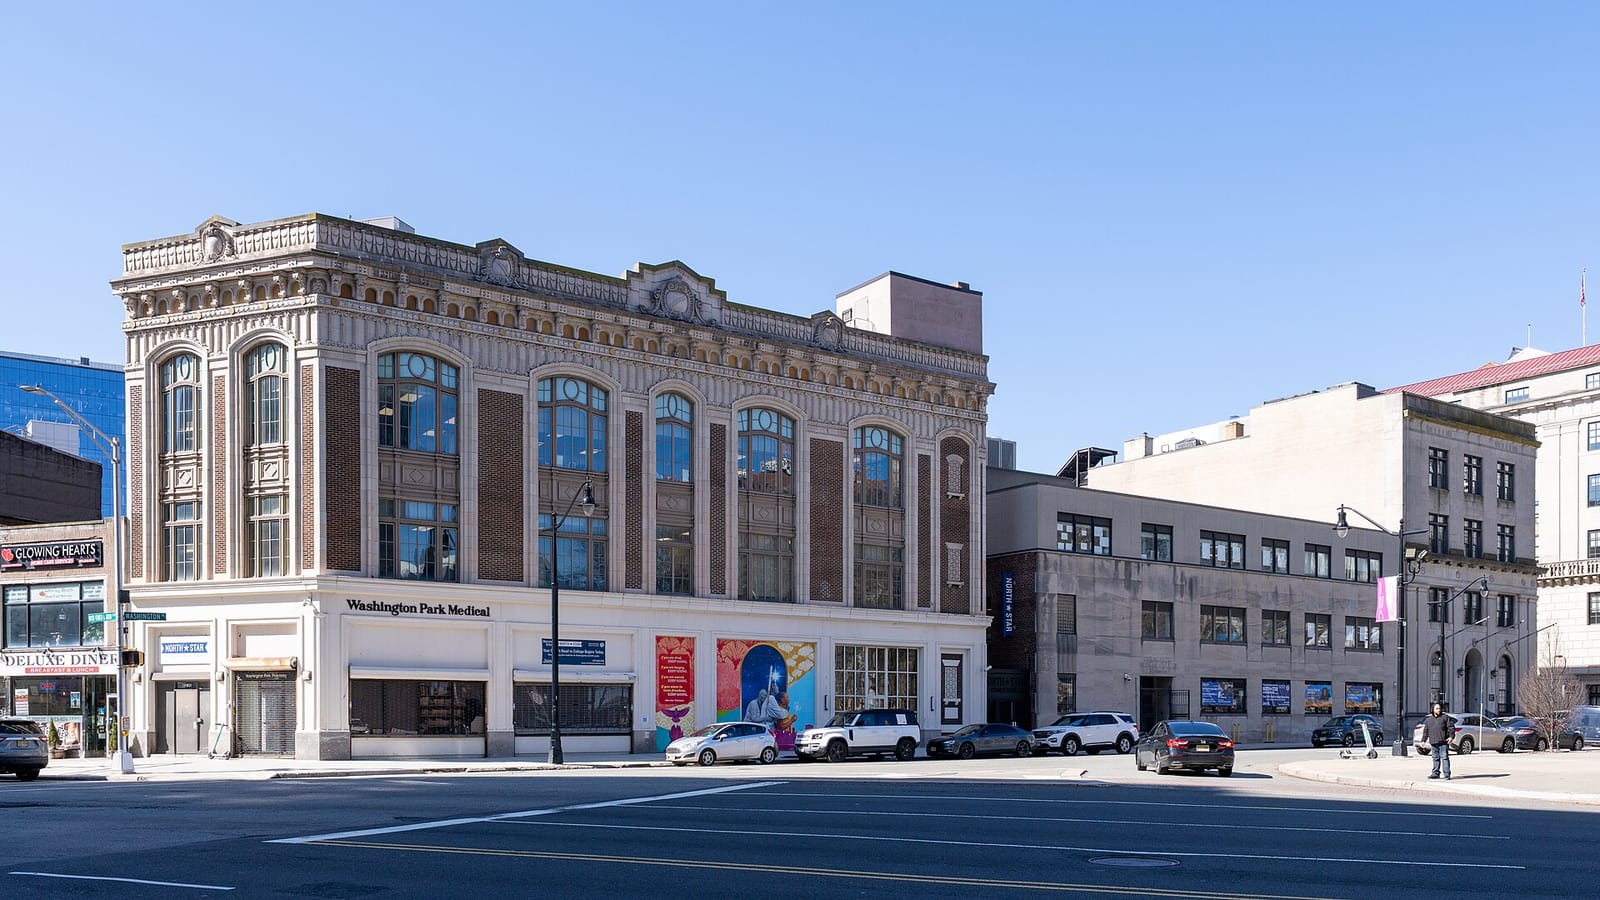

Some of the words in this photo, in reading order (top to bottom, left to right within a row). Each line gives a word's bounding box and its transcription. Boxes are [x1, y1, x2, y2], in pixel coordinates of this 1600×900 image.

[15, 545, 60, 559] GLOWING
[62, 543, 96, 556] HEARTS
[1005, 577, 1013, 604] NORTH
[125, 612, 161, 620] WASHINGTON
[346, 599, 417, 616] Washington
[419, 602, 447, 615] Park
[448, 604, 491, 617] Medical
[1005, 612, 1013, 632] STAR
[164, 643, 184, 652] NORTH
[189, 643, 204, 652] STAR
[5, 654, 65, 667] DELUXE
